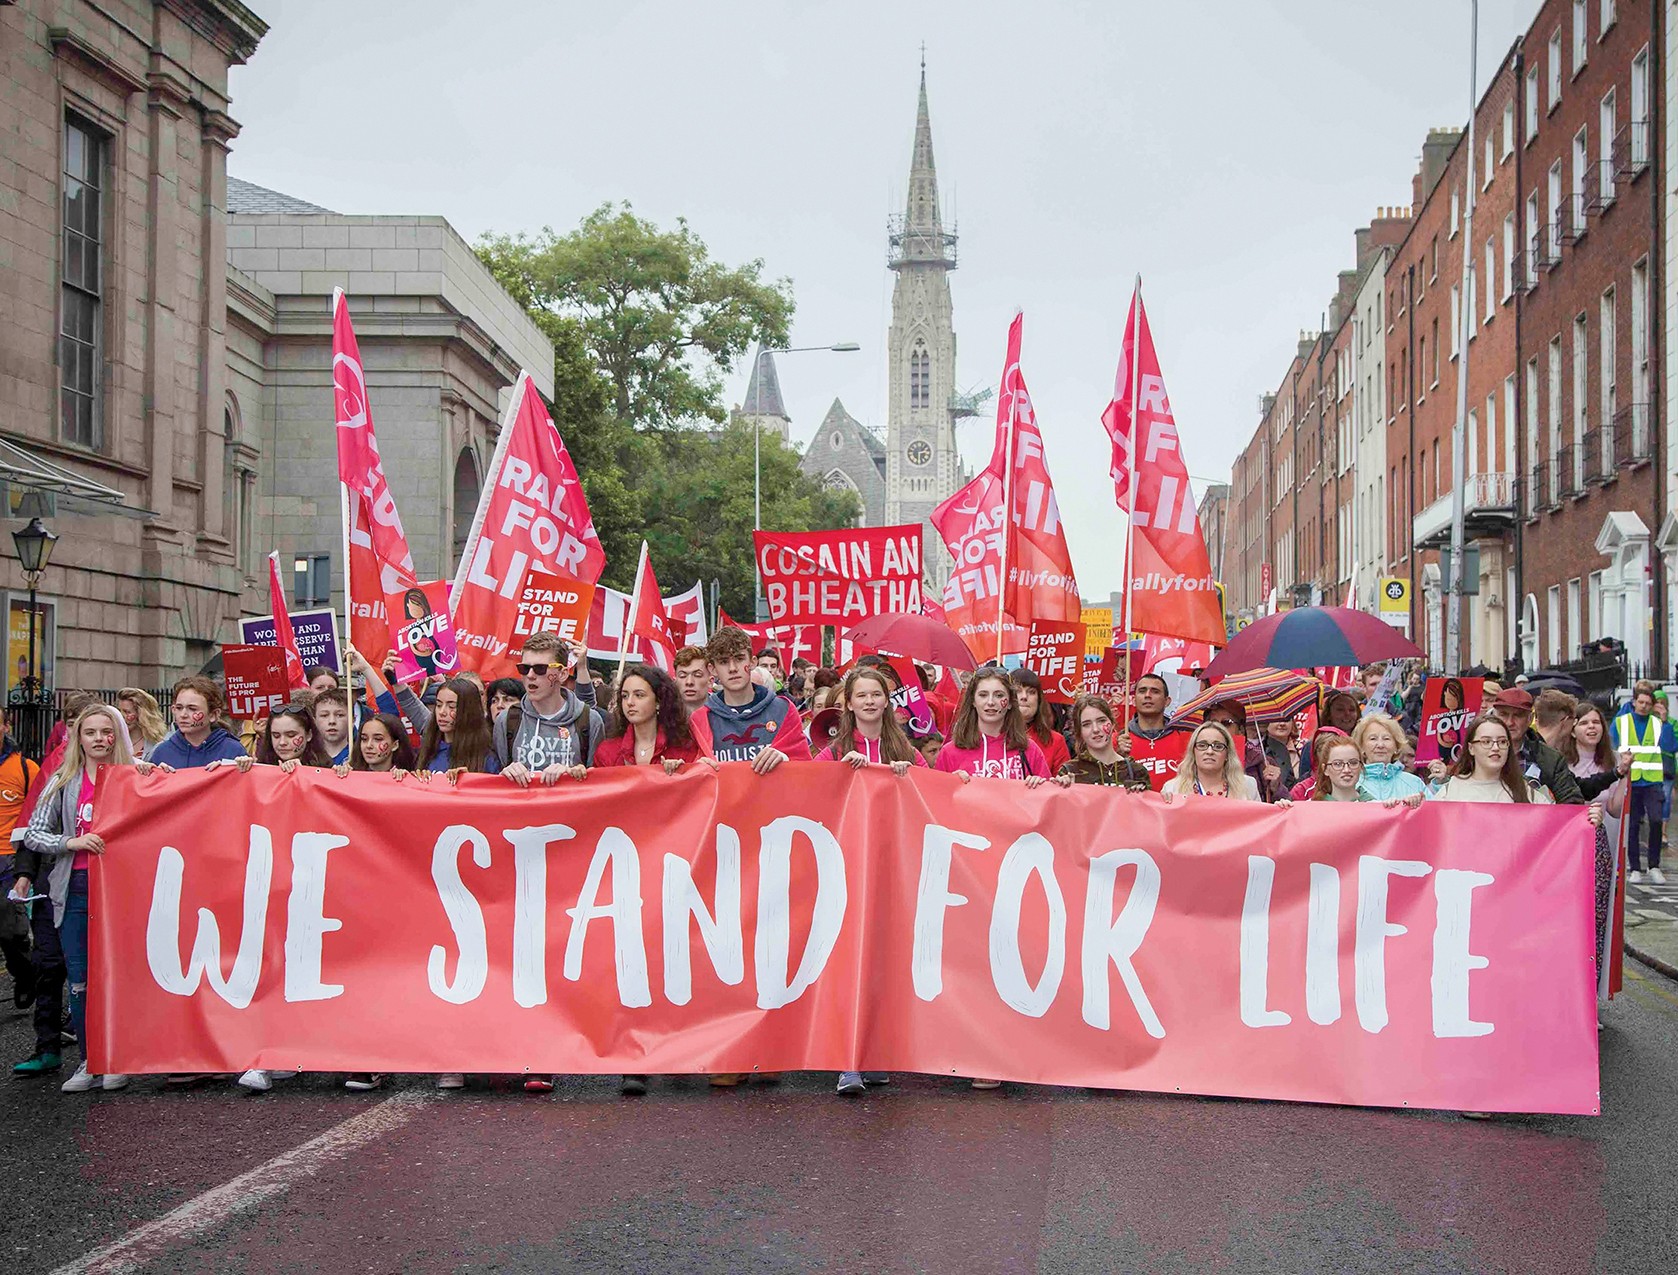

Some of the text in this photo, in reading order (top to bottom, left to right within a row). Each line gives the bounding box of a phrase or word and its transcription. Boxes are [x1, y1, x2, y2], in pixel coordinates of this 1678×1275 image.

[501, 499, 588, 577] FOR
[761, 536, 919, 579] COSAIN AN
[526, 574, 534, 586] I
[522, 588, 579, 604] STAND
[768, 579, 921, 620] BHEATHA
[519, 602, 554, 616] FOR
[298, 624, 320, 634] AND
[397, 613, 448, 650] LOVE
[514, 614, 578, 639] LIFE
[1031, 623, 1037, 633] I
[1030, 632, 1075, 646] STAND
[1028, 646, 1056, 659] FOR
[1027, 656, 1077, 677] LIFE
[229, 682, 260, 690] FUTURE
[231, 694, 284, 714] LIFE
[1429, 711, 1457, 720] ABORTION
[1143, 760, 1166, 774] FE
[145, 815, 1495, 1039] WE STAND FOR LIFE
